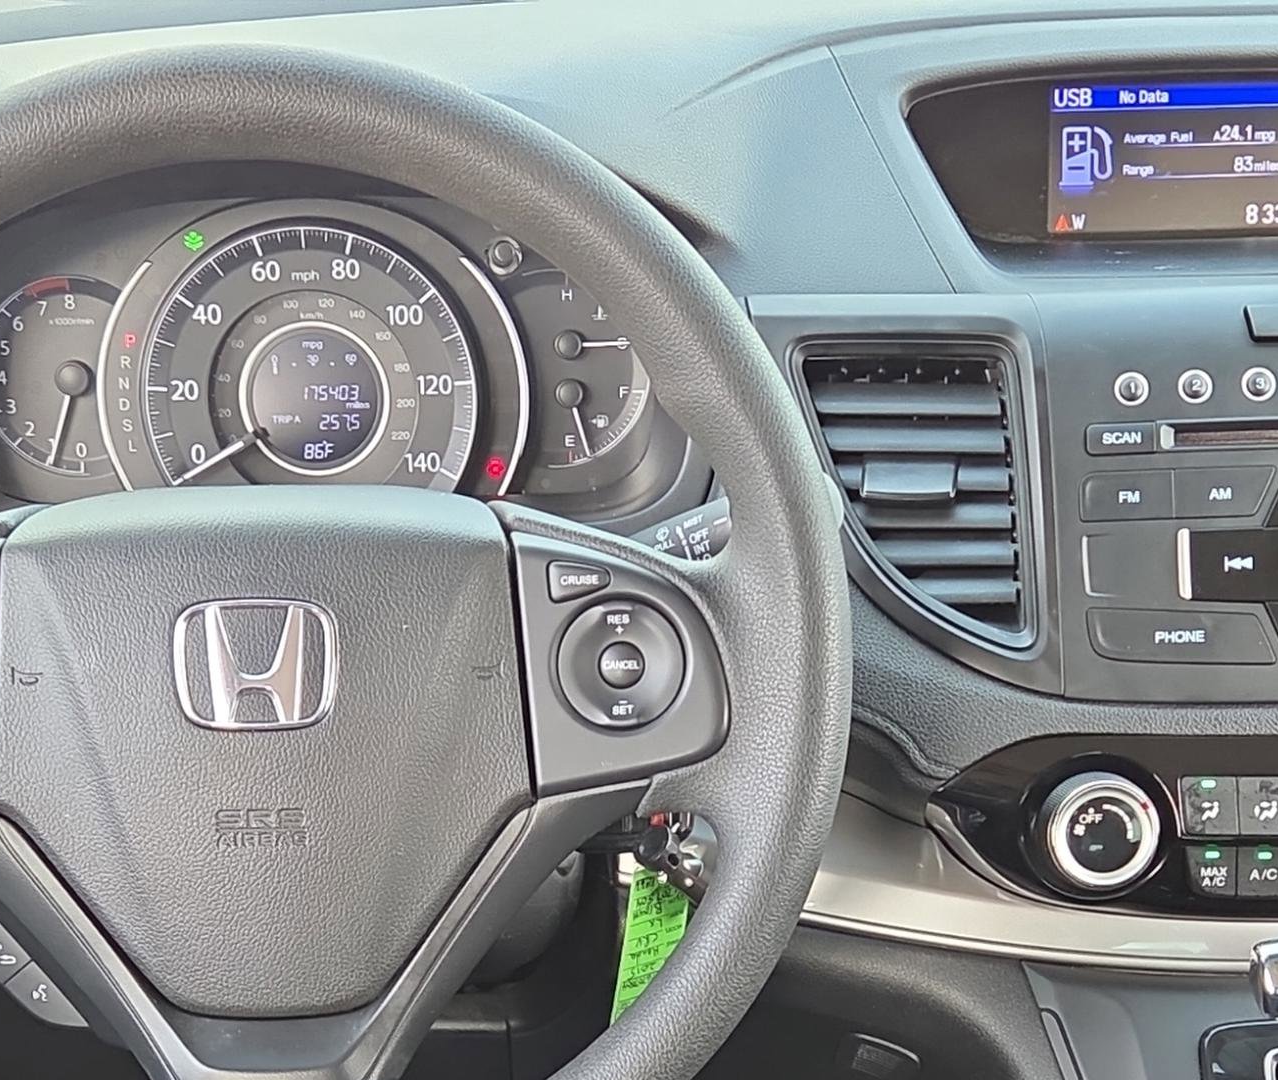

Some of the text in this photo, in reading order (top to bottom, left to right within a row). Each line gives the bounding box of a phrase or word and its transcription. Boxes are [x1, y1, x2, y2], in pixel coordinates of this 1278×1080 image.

[1054, 88, 1093, 107] USB
[1119, 90, 1169, 105] No Data
[1123, 132, 1166, 145] Average
[1170, 131, 1193, 143] Fuel
[1122, 164, 1154, 177] Range
[1072, 214, 1086, 230] W
[251, 261, 281, 282] 60
[331, 258, 360, 280] 80
[291, 269, 319, 284] mph
[65, 294, 75, 310] 8
[561, 289, 572, 301] H
[37, 301, 47, 316] 7
[192, 303, 222, 325] 40
[349, 310, 366, 319] 140
[386, 304, 423, 325] 100
[13, 317, 23, 331] 6
[125, 334, 136, 347] P
[302, 340, 324, 350] mpg
[0, 341, 10, 355] 5
[121, 356, 131, 369] R
[119, 377, 129, 390] N
[170, 380, 199, 401] 20
[416, 374, 453, 396] 120
[1129, 382, 1136, 393] 1
[1191, 380, 1202, 391] 2
[1255, 378, 1266, 390] 3
[304, 385, 359, 401] 175403
[619, 386, 629, 398] F
[6, 399, 16, 414] 3
[119, 398, 130, 411] D
[123, 419, 133, 432] S
[272, 415, 293, 424] TRIP
[294, 415, 302, 424] A
[24, 421, 35, 436] 2
[391, 431, 410, 441] 220
[565, 435, 575, 447] E
[1102, 431, 1141, 445] SCAN
[76, 443, 87, 457] 0
[128, 440, 137, 453] L
[190, 443, 207, 466] 0
[404, 451, 441, 473] 140
[1118, 491, 1140, 503] FM
[1208, 487, 1232, 501] AM
[689, 527, 709, 544] OFF
[692, 540, 710, 555] INT
[560, 574, 600, 585] CRUISE
[606, 614, 630, 625] RES
[1154, 630, 1205, 644] PHONE
[602, 660, 640, 670] CANCEL
[612, 704, 634, 715] SET
[215, 808, 305, 829] SRS
[1079, 813, 1103, 825] OFF
[216, 831, 309, 849] AIRBAG
[1200, 867, 1227, 878] MAX
[1249, 868, 1278, 881] A/C
[1201, 876, 1227, 887] A/C
